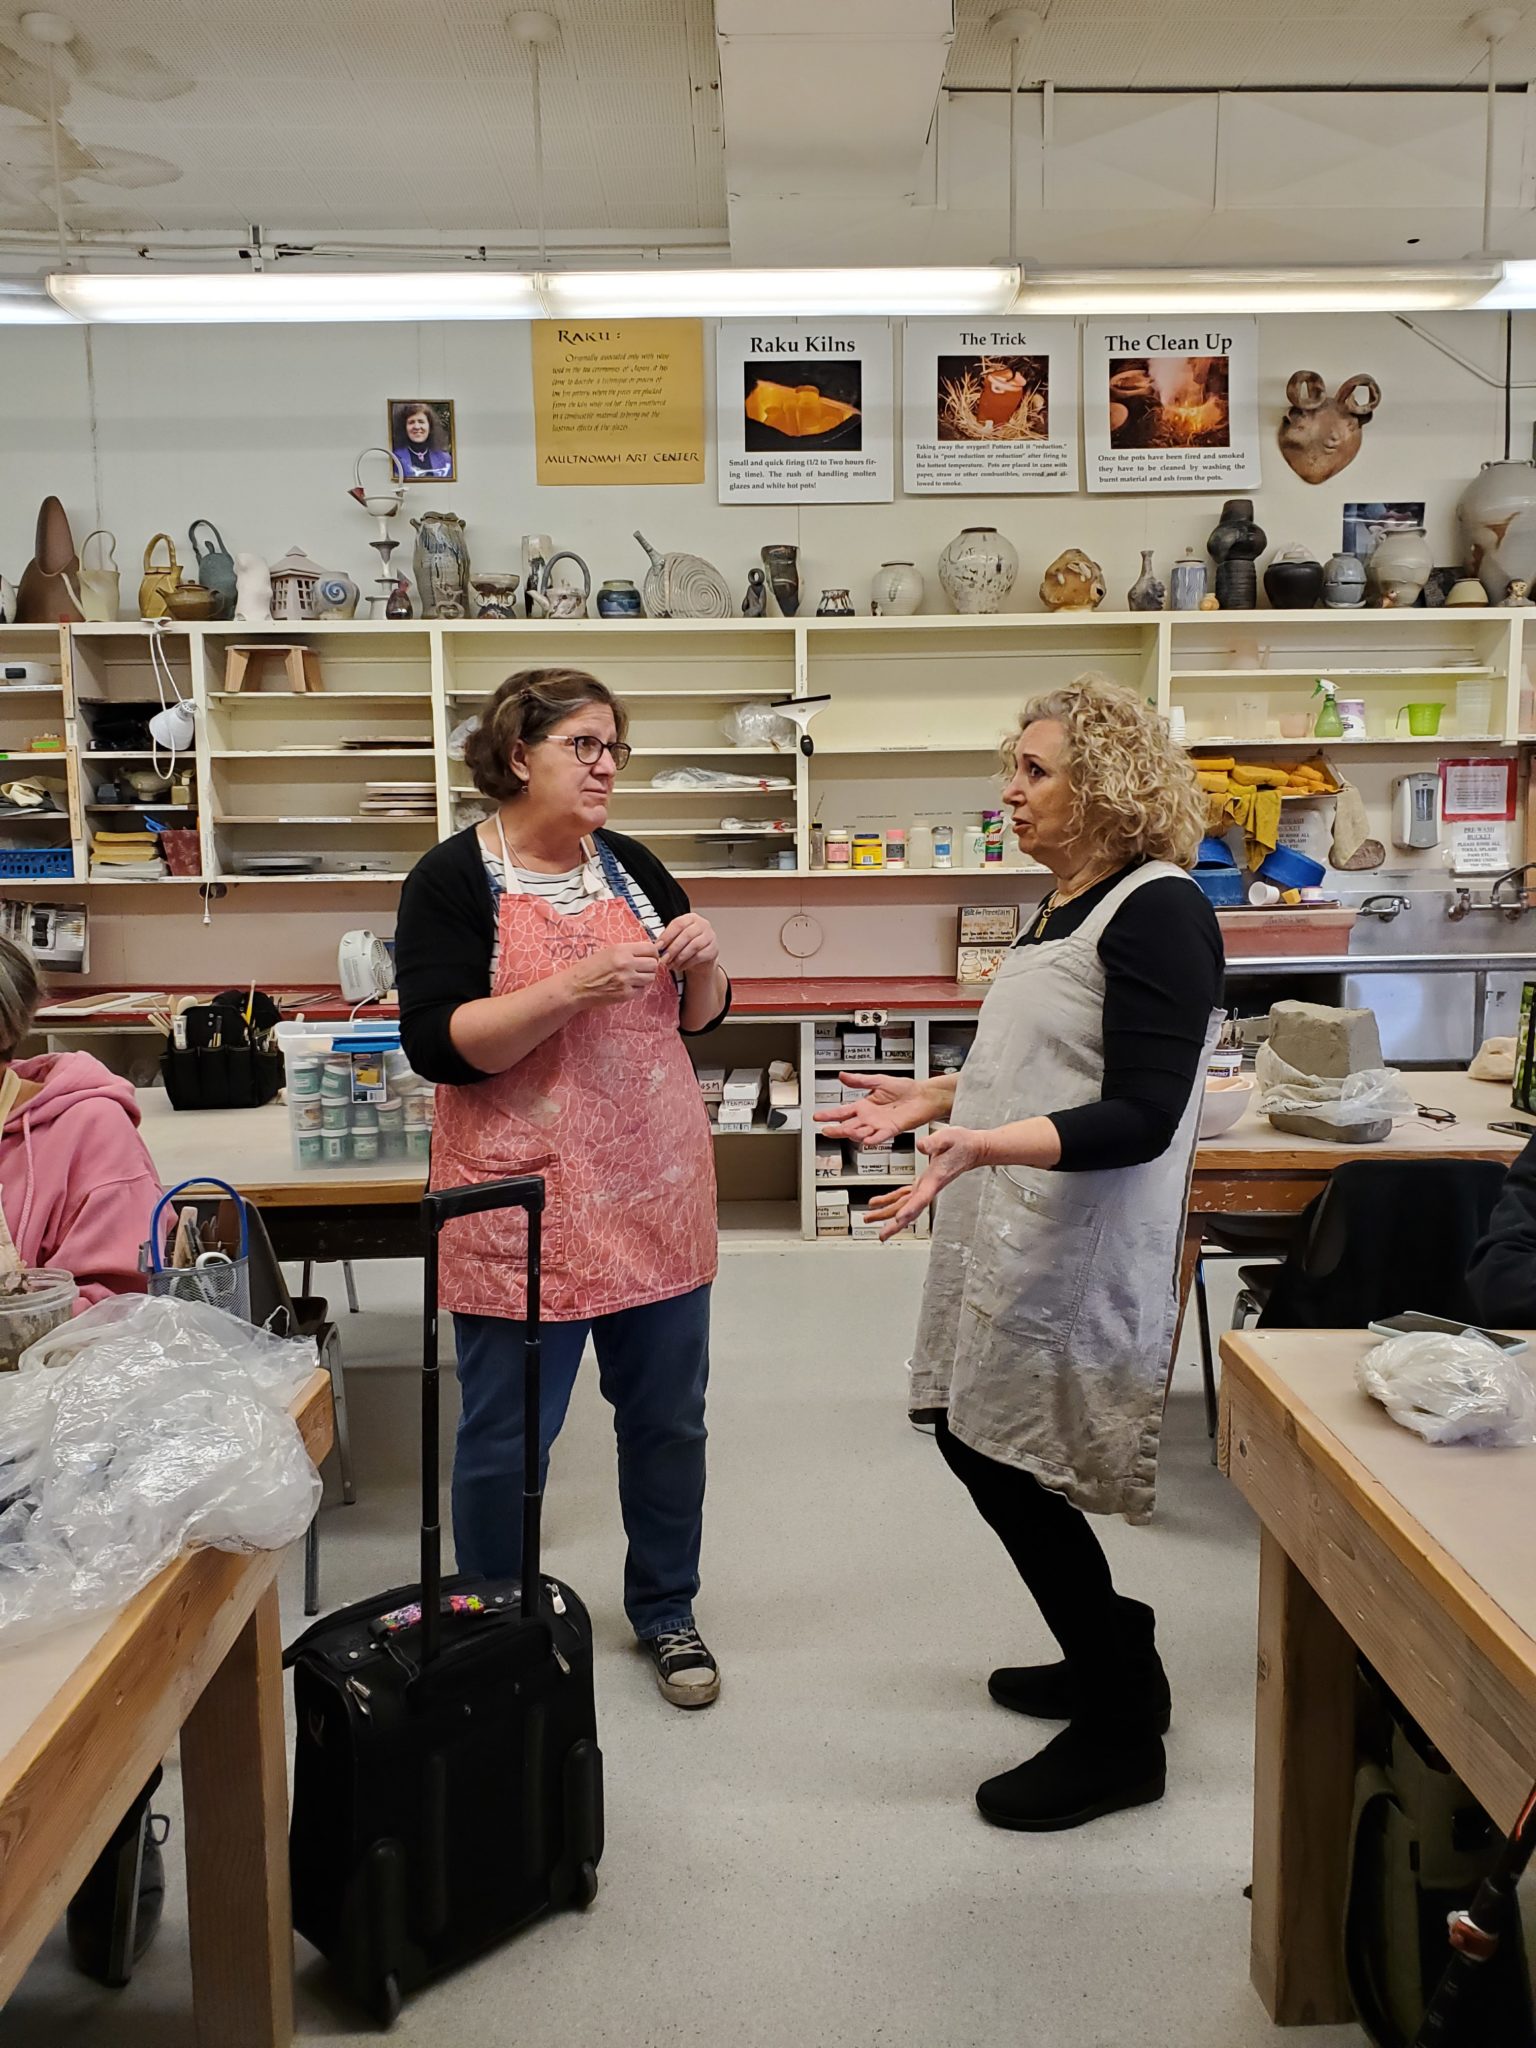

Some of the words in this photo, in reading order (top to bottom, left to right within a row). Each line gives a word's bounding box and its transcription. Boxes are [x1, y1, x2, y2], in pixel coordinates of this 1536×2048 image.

[750, 337, 799, 352] Raku
[805, 336, 855, 352] Kilns
[960, 333, 986, 345] The
[991, 333, 1026, 345] Trick
[1105, 335, 1140, 351] The
[1146, 334, 1199, 350] Clean
[1206, 334, 1232, 354] Up
[545, 454, 621, 464] MULTNOMAH
[625, 454, 647, 463] ART
[653, 452, 700, 462] CENTER
[765, 459, 784, 469] quick
[786, 459, 805, 468] firing
[1190, 464, 1198, 472] by
[729, 471, 740, 479] ing
[769, 470, 782, 478] The
[818, 470, 848, 479] handling
[729, 483, 750, 491] glazes
[800, 482, 816, 491] pots!
